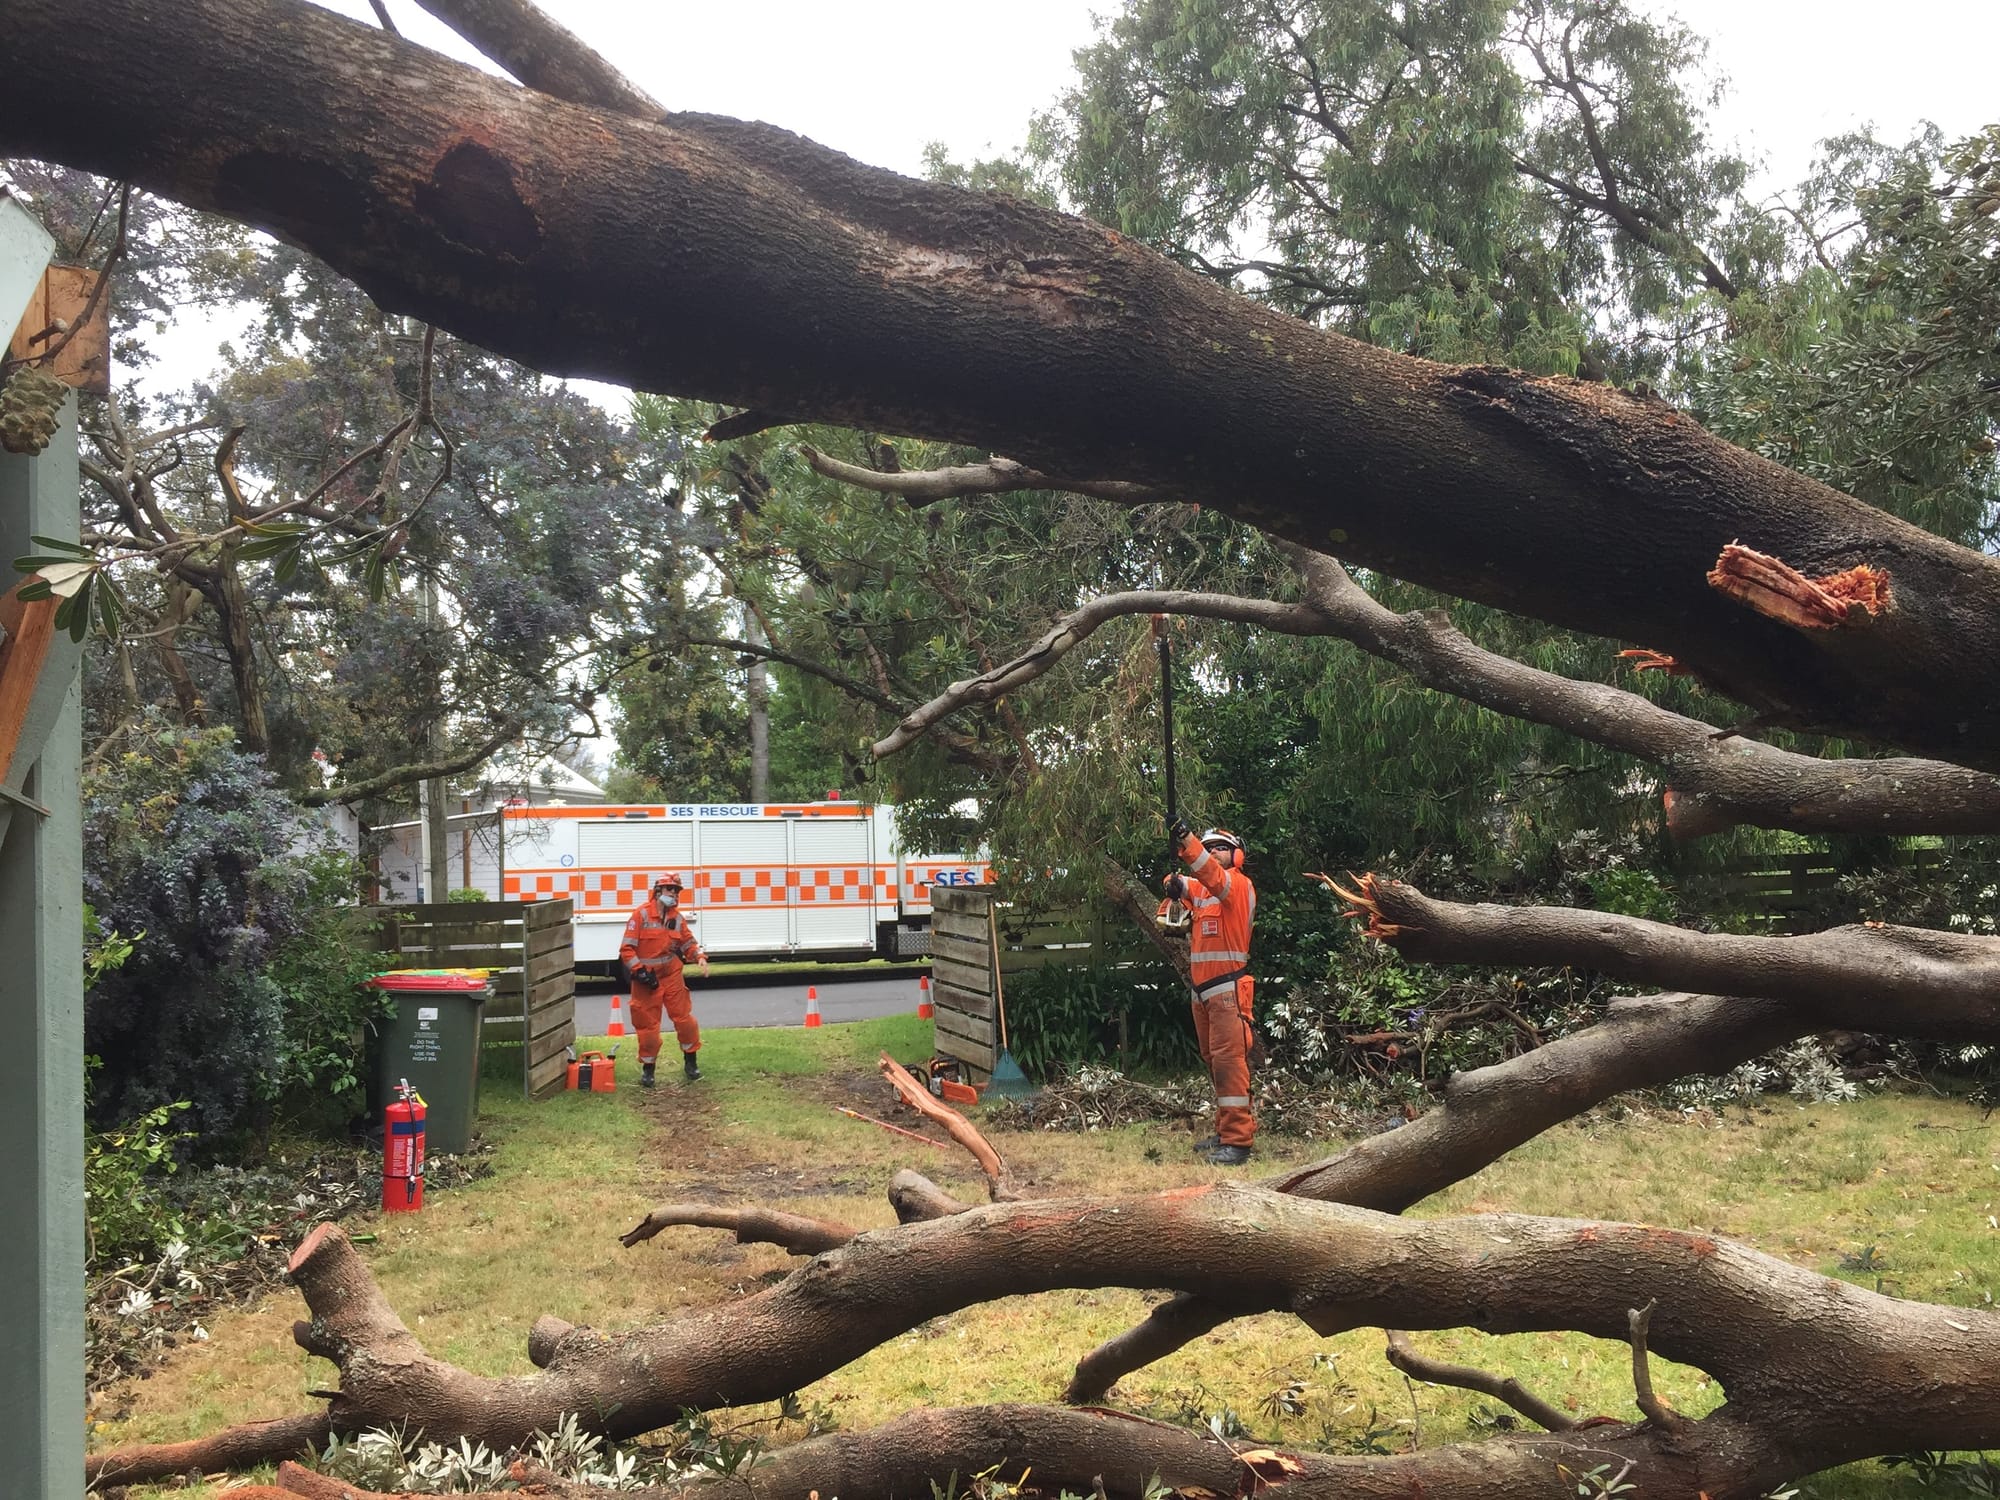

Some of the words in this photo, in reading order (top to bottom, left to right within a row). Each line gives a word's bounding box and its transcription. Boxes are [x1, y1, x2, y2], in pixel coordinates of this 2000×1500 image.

[671, 807, 694, 816] SES
[700, 806, 759, 816] RESCUE
[935, 872, 976, 886] SES
